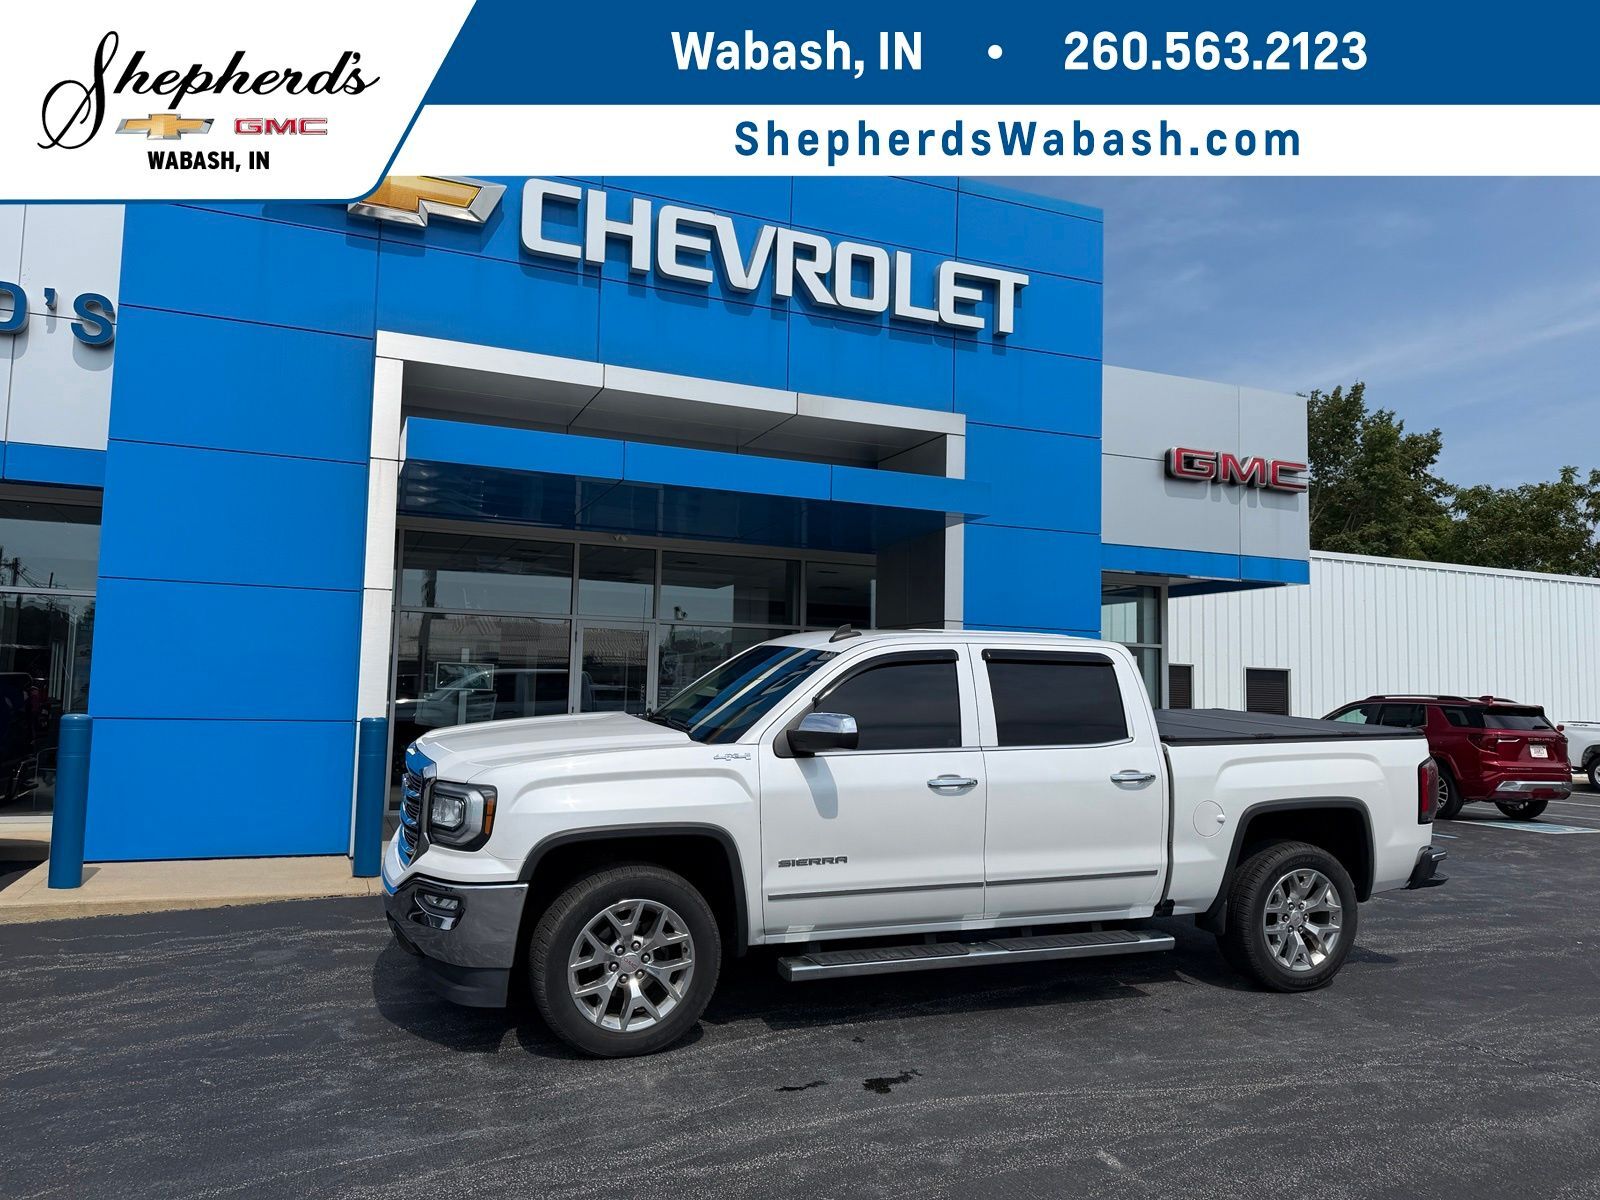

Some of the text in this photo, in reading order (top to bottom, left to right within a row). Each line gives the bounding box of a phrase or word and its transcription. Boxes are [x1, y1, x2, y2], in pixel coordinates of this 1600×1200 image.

[519, 178, 1029, 336] CHEVROLET
[1165, 446, 1308, 493] GMC
[778, 856, 848, 868] SIERRA
